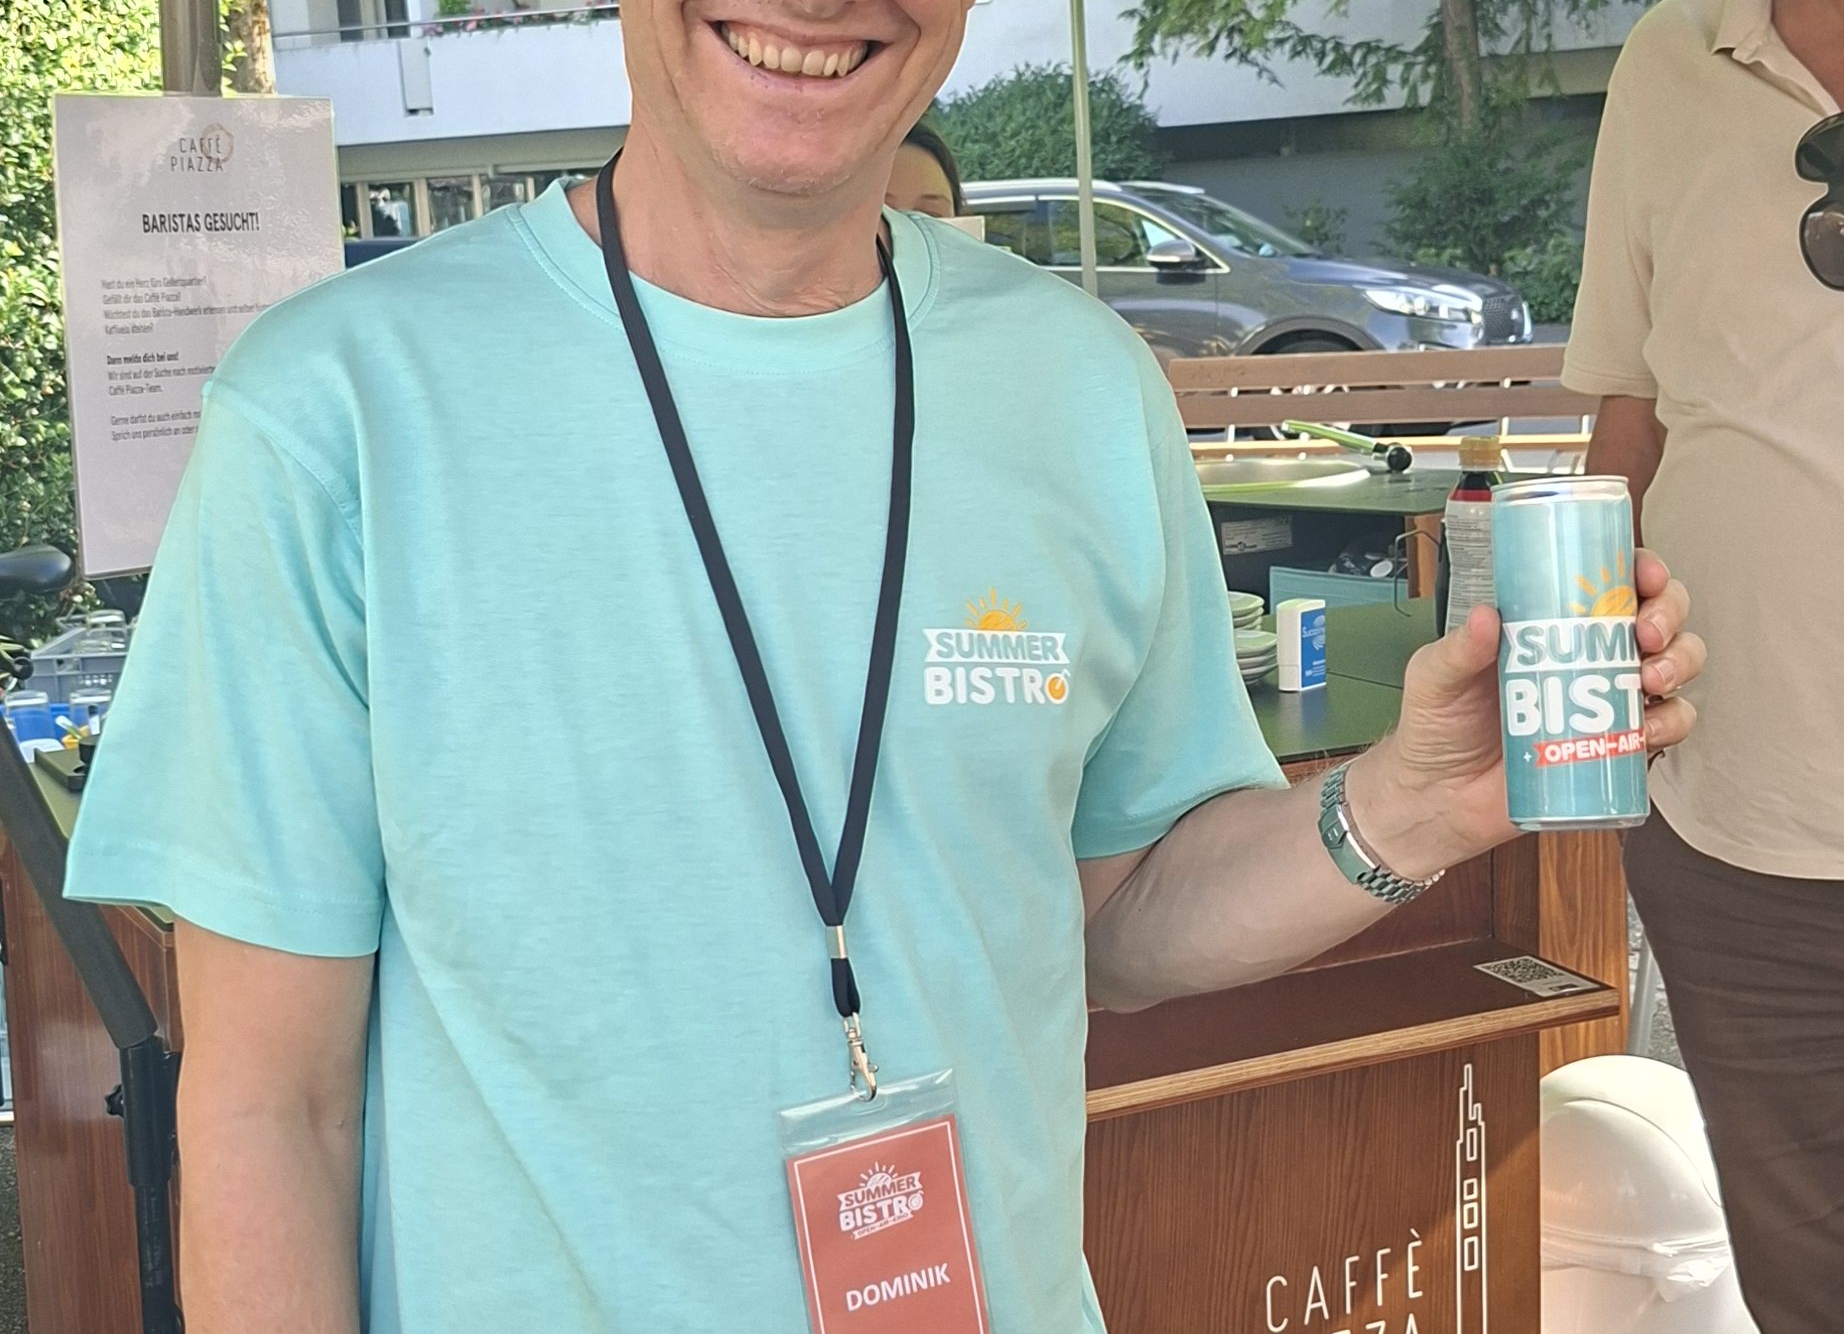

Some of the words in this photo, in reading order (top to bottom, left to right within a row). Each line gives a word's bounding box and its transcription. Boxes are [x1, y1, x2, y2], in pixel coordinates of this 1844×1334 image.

[179, 135, 222, 154] CAFFÈ
[170, 156, 224, 172] PIAZZA
[142, 213, 201, 233] BARISTAS
[203, 212, 260, 232] GESUCHT!
[935, 632, 1060, 661] SUMMER
[844, 1175, 917, 1207] SUMMER
[846, 1262, 951, 1312] DOMINIK
[1266, 1228, 1424, 1333] CAFFÈ
